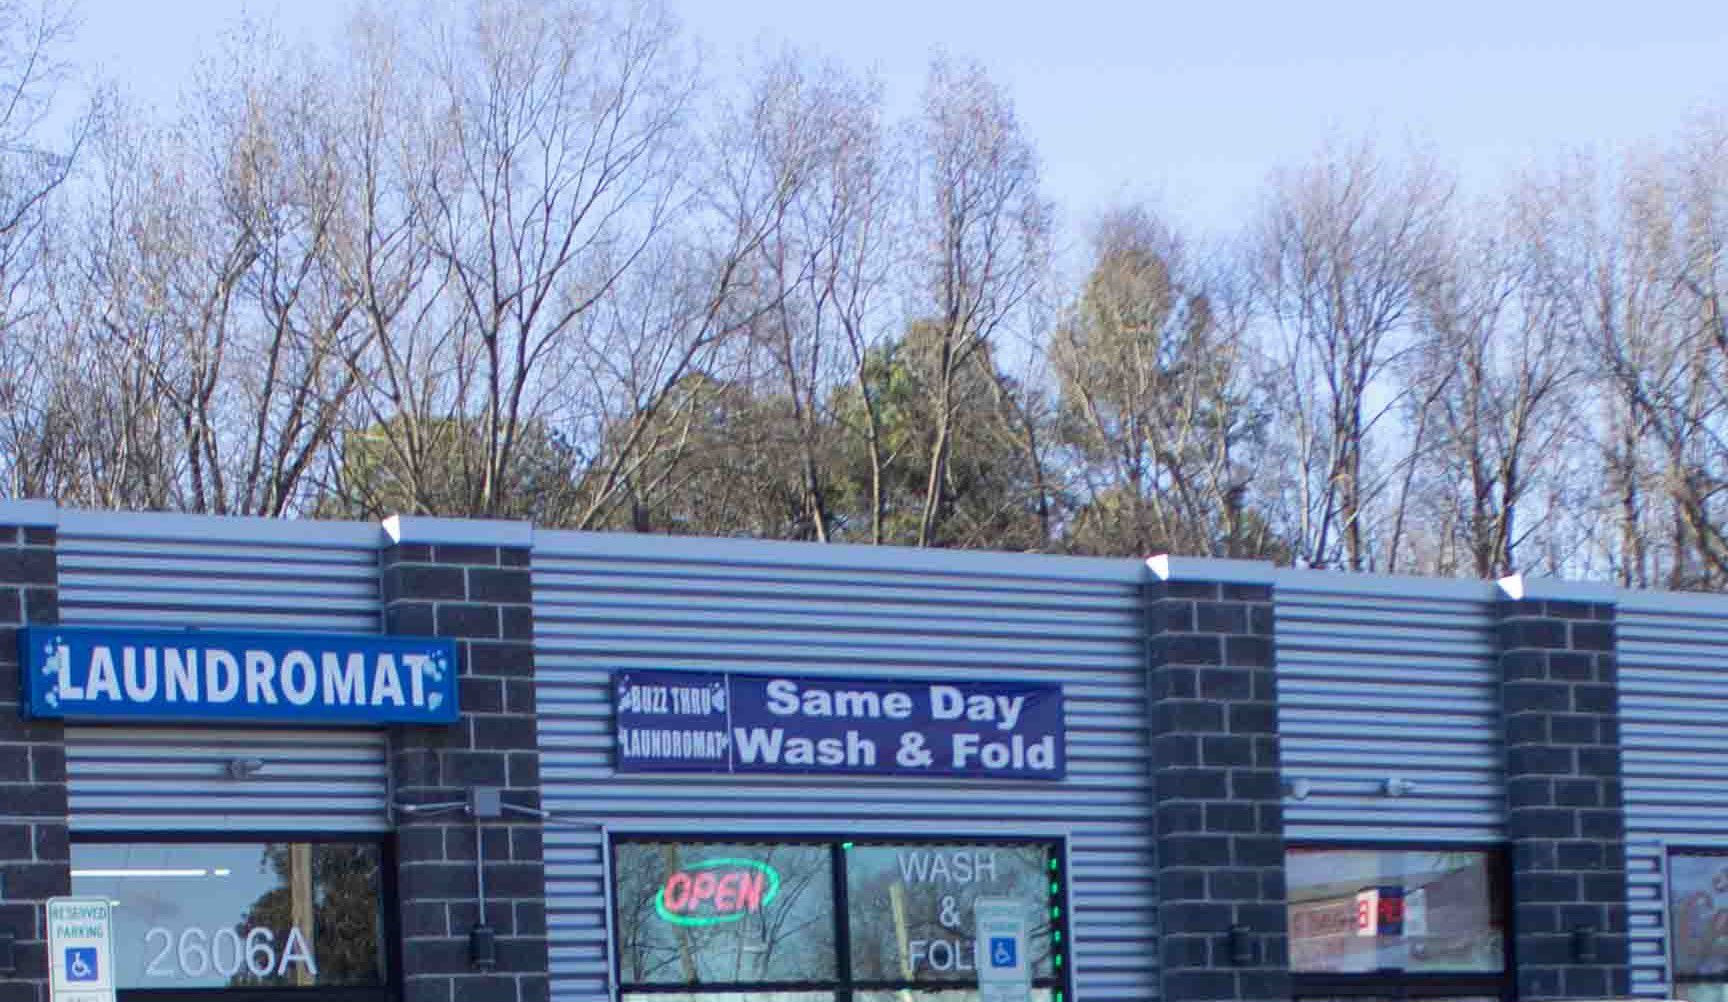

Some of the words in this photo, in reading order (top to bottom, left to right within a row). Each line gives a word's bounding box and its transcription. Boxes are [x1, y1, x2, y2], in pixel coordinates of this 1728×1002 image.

[58, 645, 429, 707] LAUNDROMAT
[632, 685, 669, 715] BUZZ
[671, 687, 712, 716] THRU
[766, 680, 913, 718] Same
[929, 685, 1025, 731] Day
[623, 729, 722, 758] LAUNDROMAT
[733, 727, 877, 766] Wash
[896, 731, 934, 768] &
[952, 733, 1056, 770] Fold
[897, 852, 997, 883] WASH
[663, 871, 764, 914] OPEN
[51, 904, 107, 920] RESERVED
[939, 895, 961, 927] &
[57, 925, 104, 939] PARKING
[145, 926, 318, 977] 2606A
[909, 938, 975, 972] FOL
